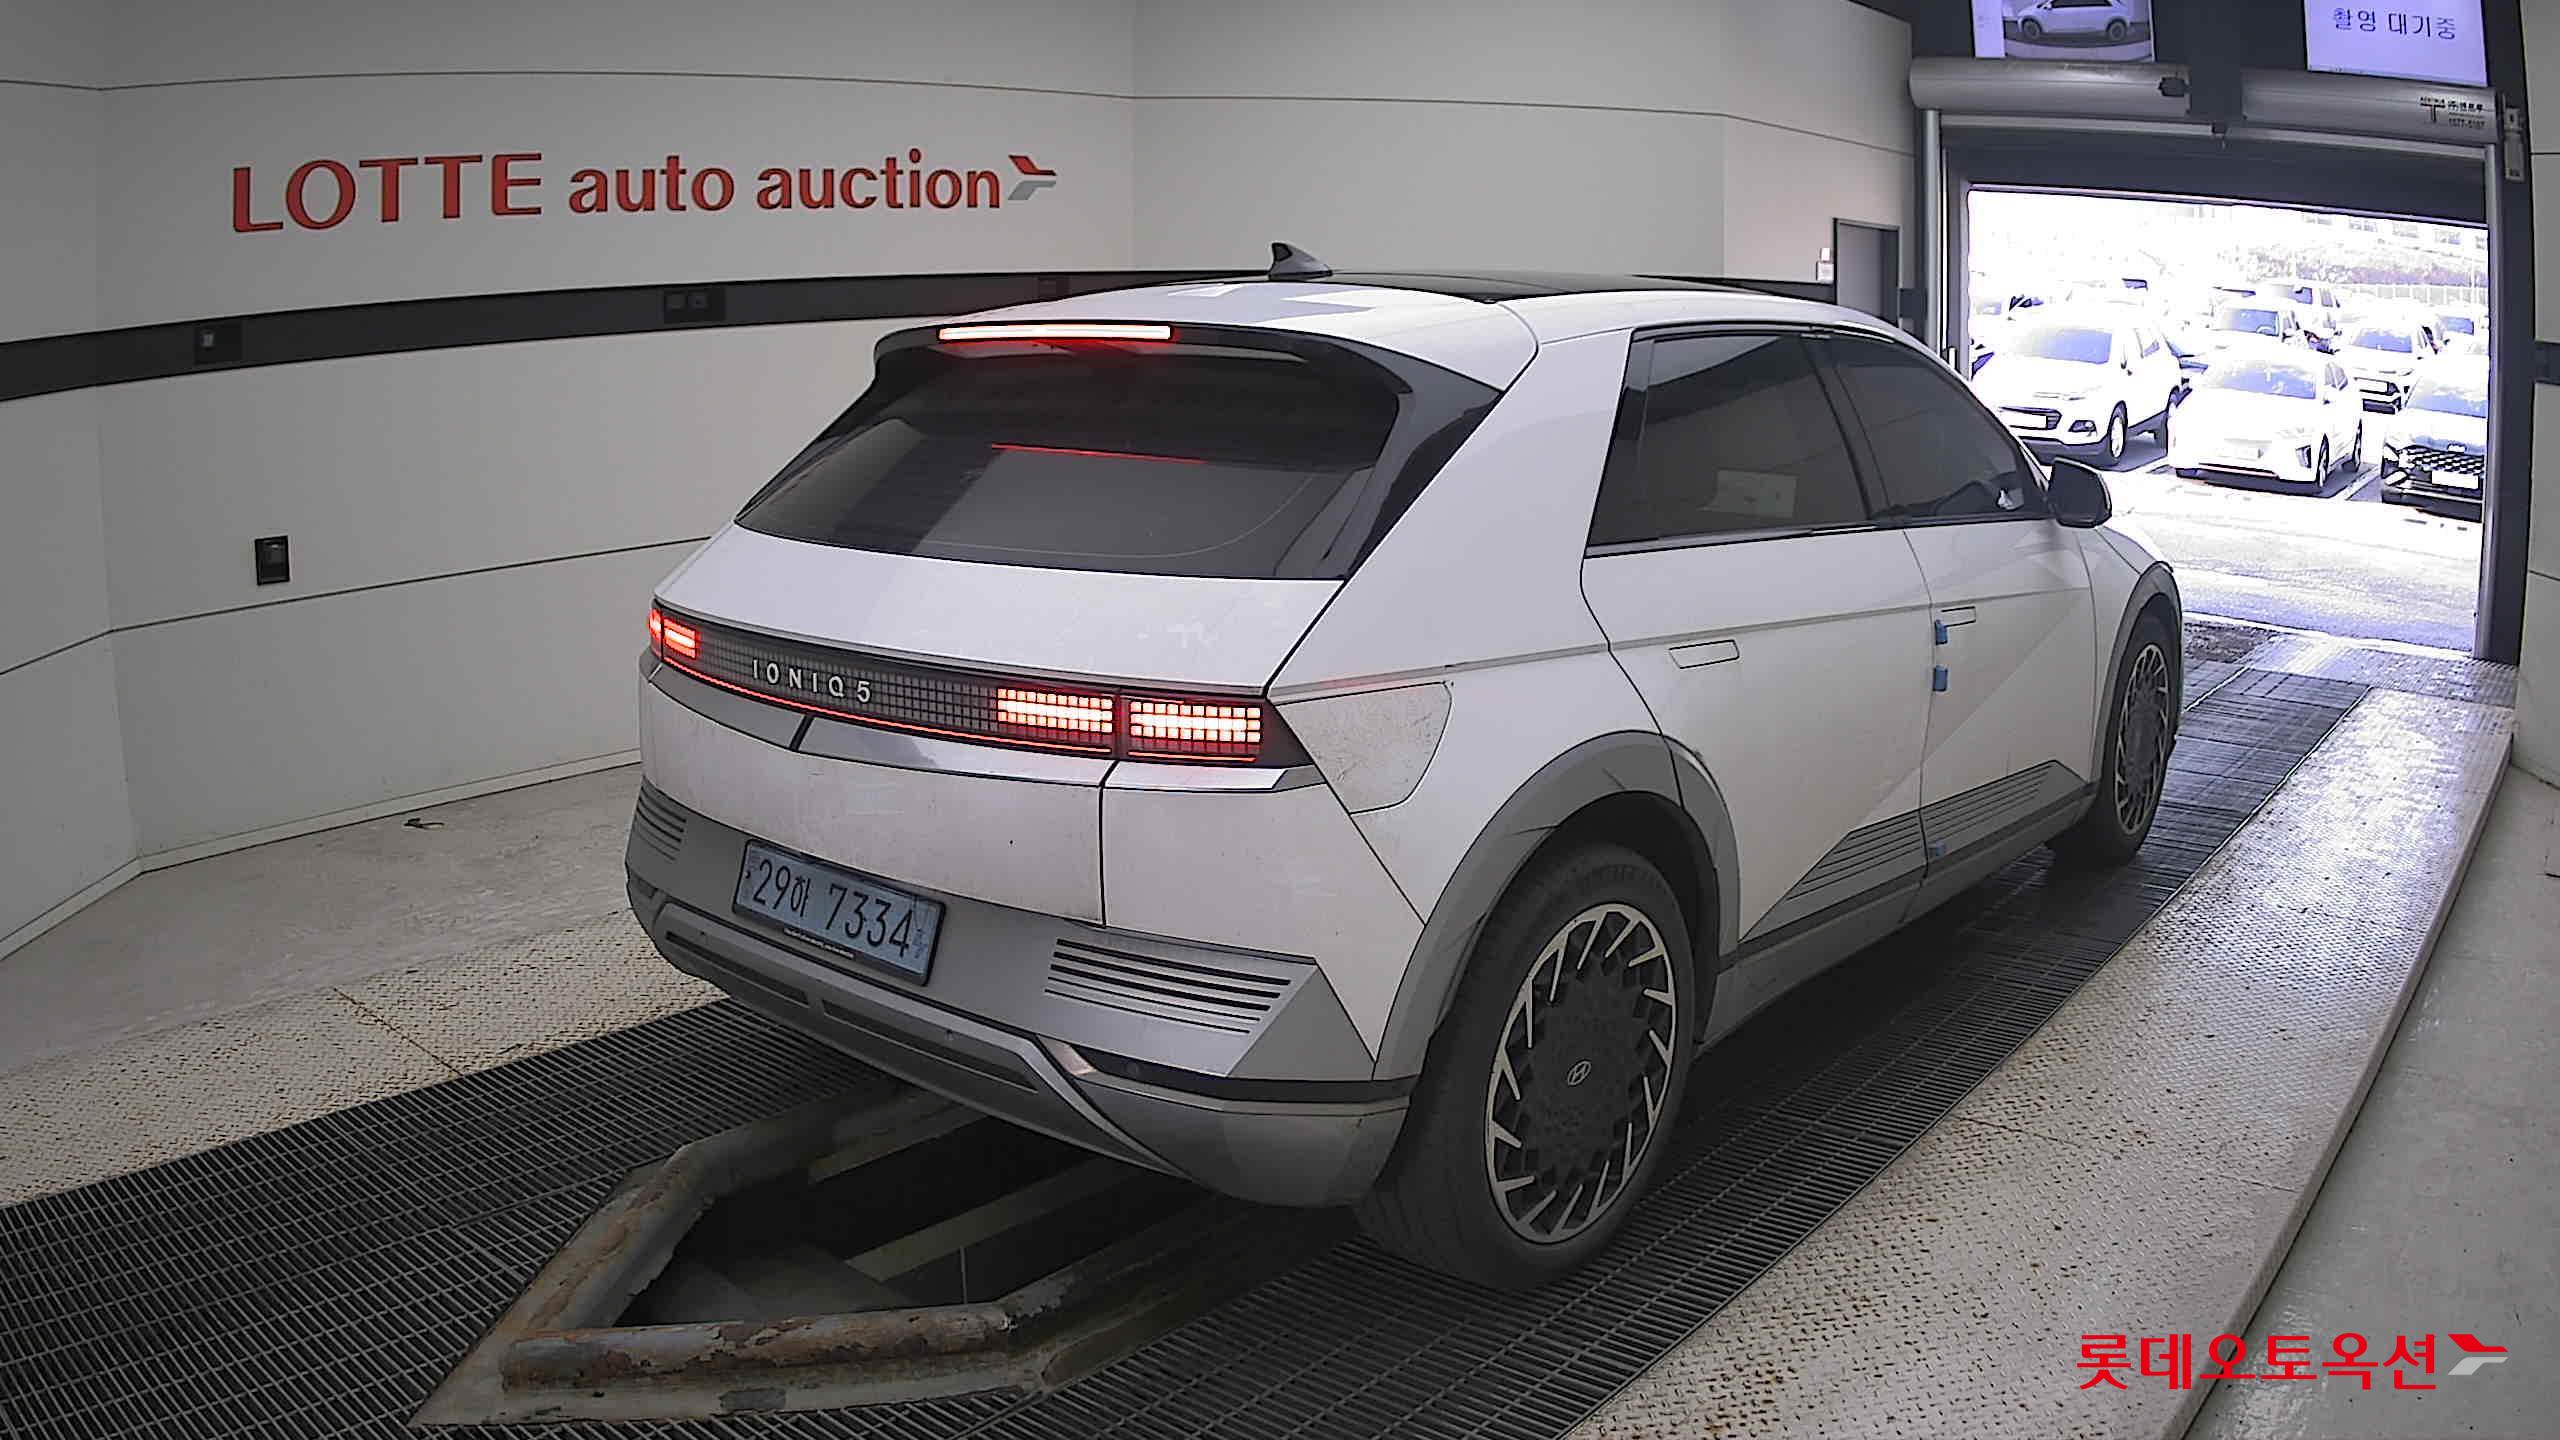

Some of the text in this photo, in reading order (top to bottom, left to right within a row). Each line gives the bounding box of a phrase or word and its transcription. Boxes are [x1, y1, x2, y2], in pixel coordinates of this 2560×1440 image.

[2387, 12, 2456, 40] 대기중
[233, 148, 1001, 233] LOTTE auto auction
[753, 659, 871, 703] IONIQ 5
[753, 859, 811, 918] 29하
[825, 883, 914, 958] 7334
